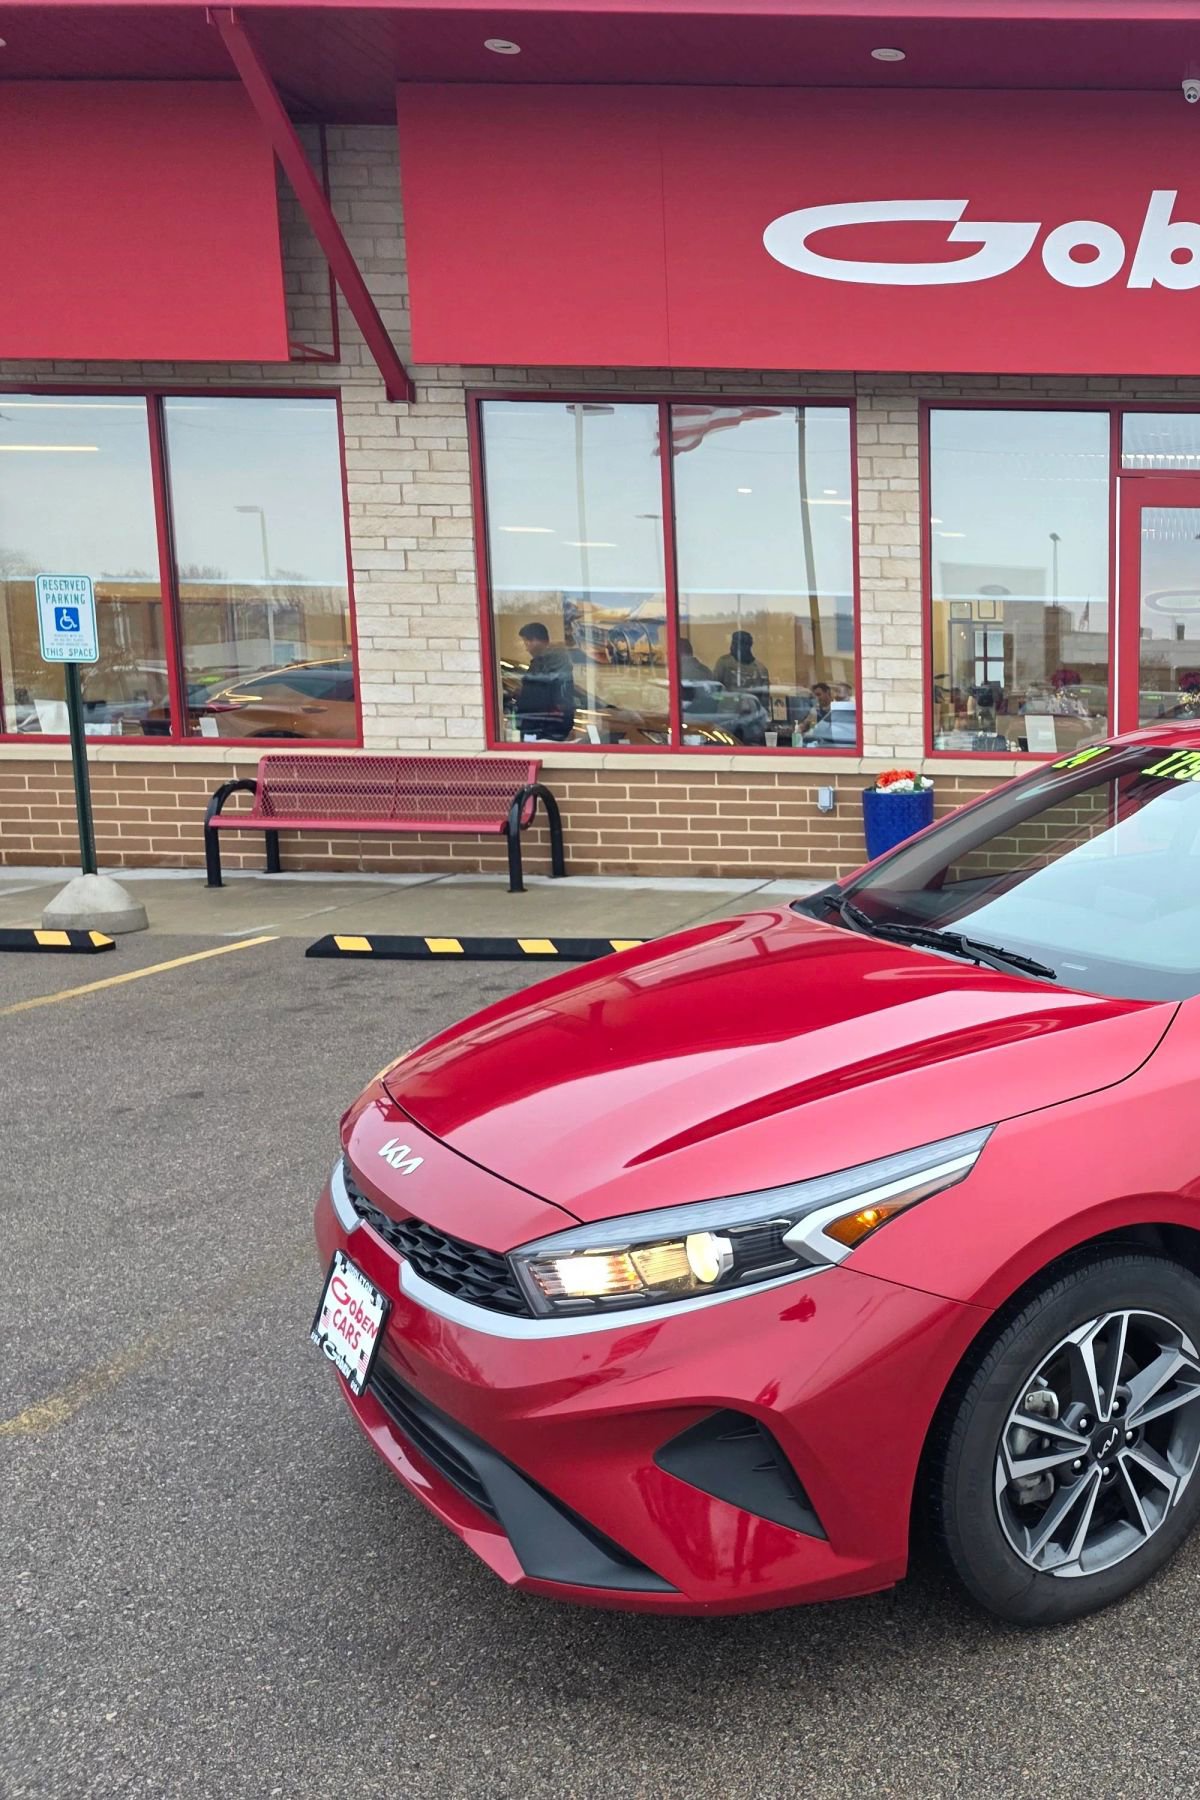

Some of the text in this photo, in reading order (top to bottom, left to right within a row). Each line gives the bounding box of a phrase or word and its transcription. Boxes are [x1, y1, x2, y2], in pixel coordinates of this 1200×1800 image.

[42, 580, 86, 591] RESERVED
[45, 593, 86, 604] PARKING
[45, 647, 94, 657] THIS SPACE
[332, 1308, 363, 1351] CARS
